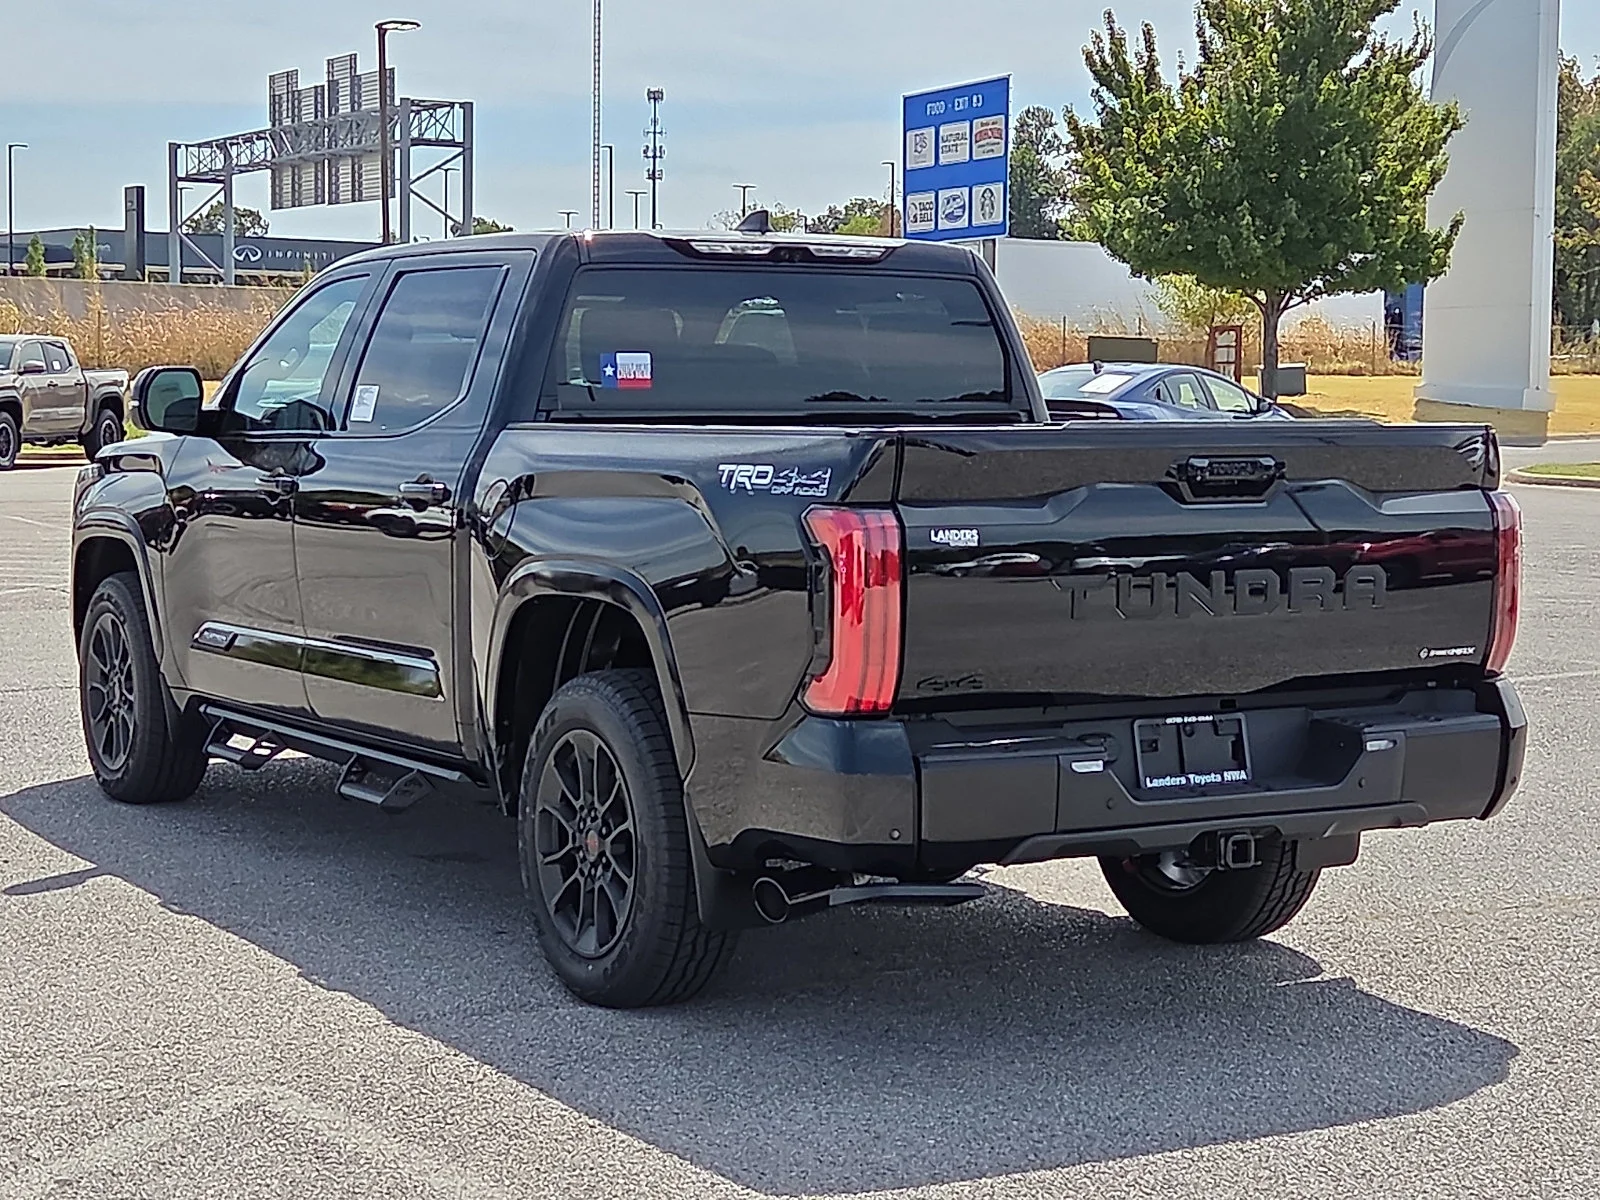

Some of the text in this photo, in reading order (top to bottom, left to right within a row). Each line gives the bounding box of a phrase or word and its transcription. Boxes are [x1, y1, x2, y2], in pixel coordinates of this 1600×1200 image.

[918, 201, 934, 212] TACO
[918, 211, 933, 223] BELL
[266, 250, 335, 261] INFINITI
[718, 464, 774, 491] TRD
[930, 528, 979, 543] LANDERS
[1048, 564, 1388, 620] TUNDRA
[1145, 769, 1248, 788] Landers Toyota NWA
